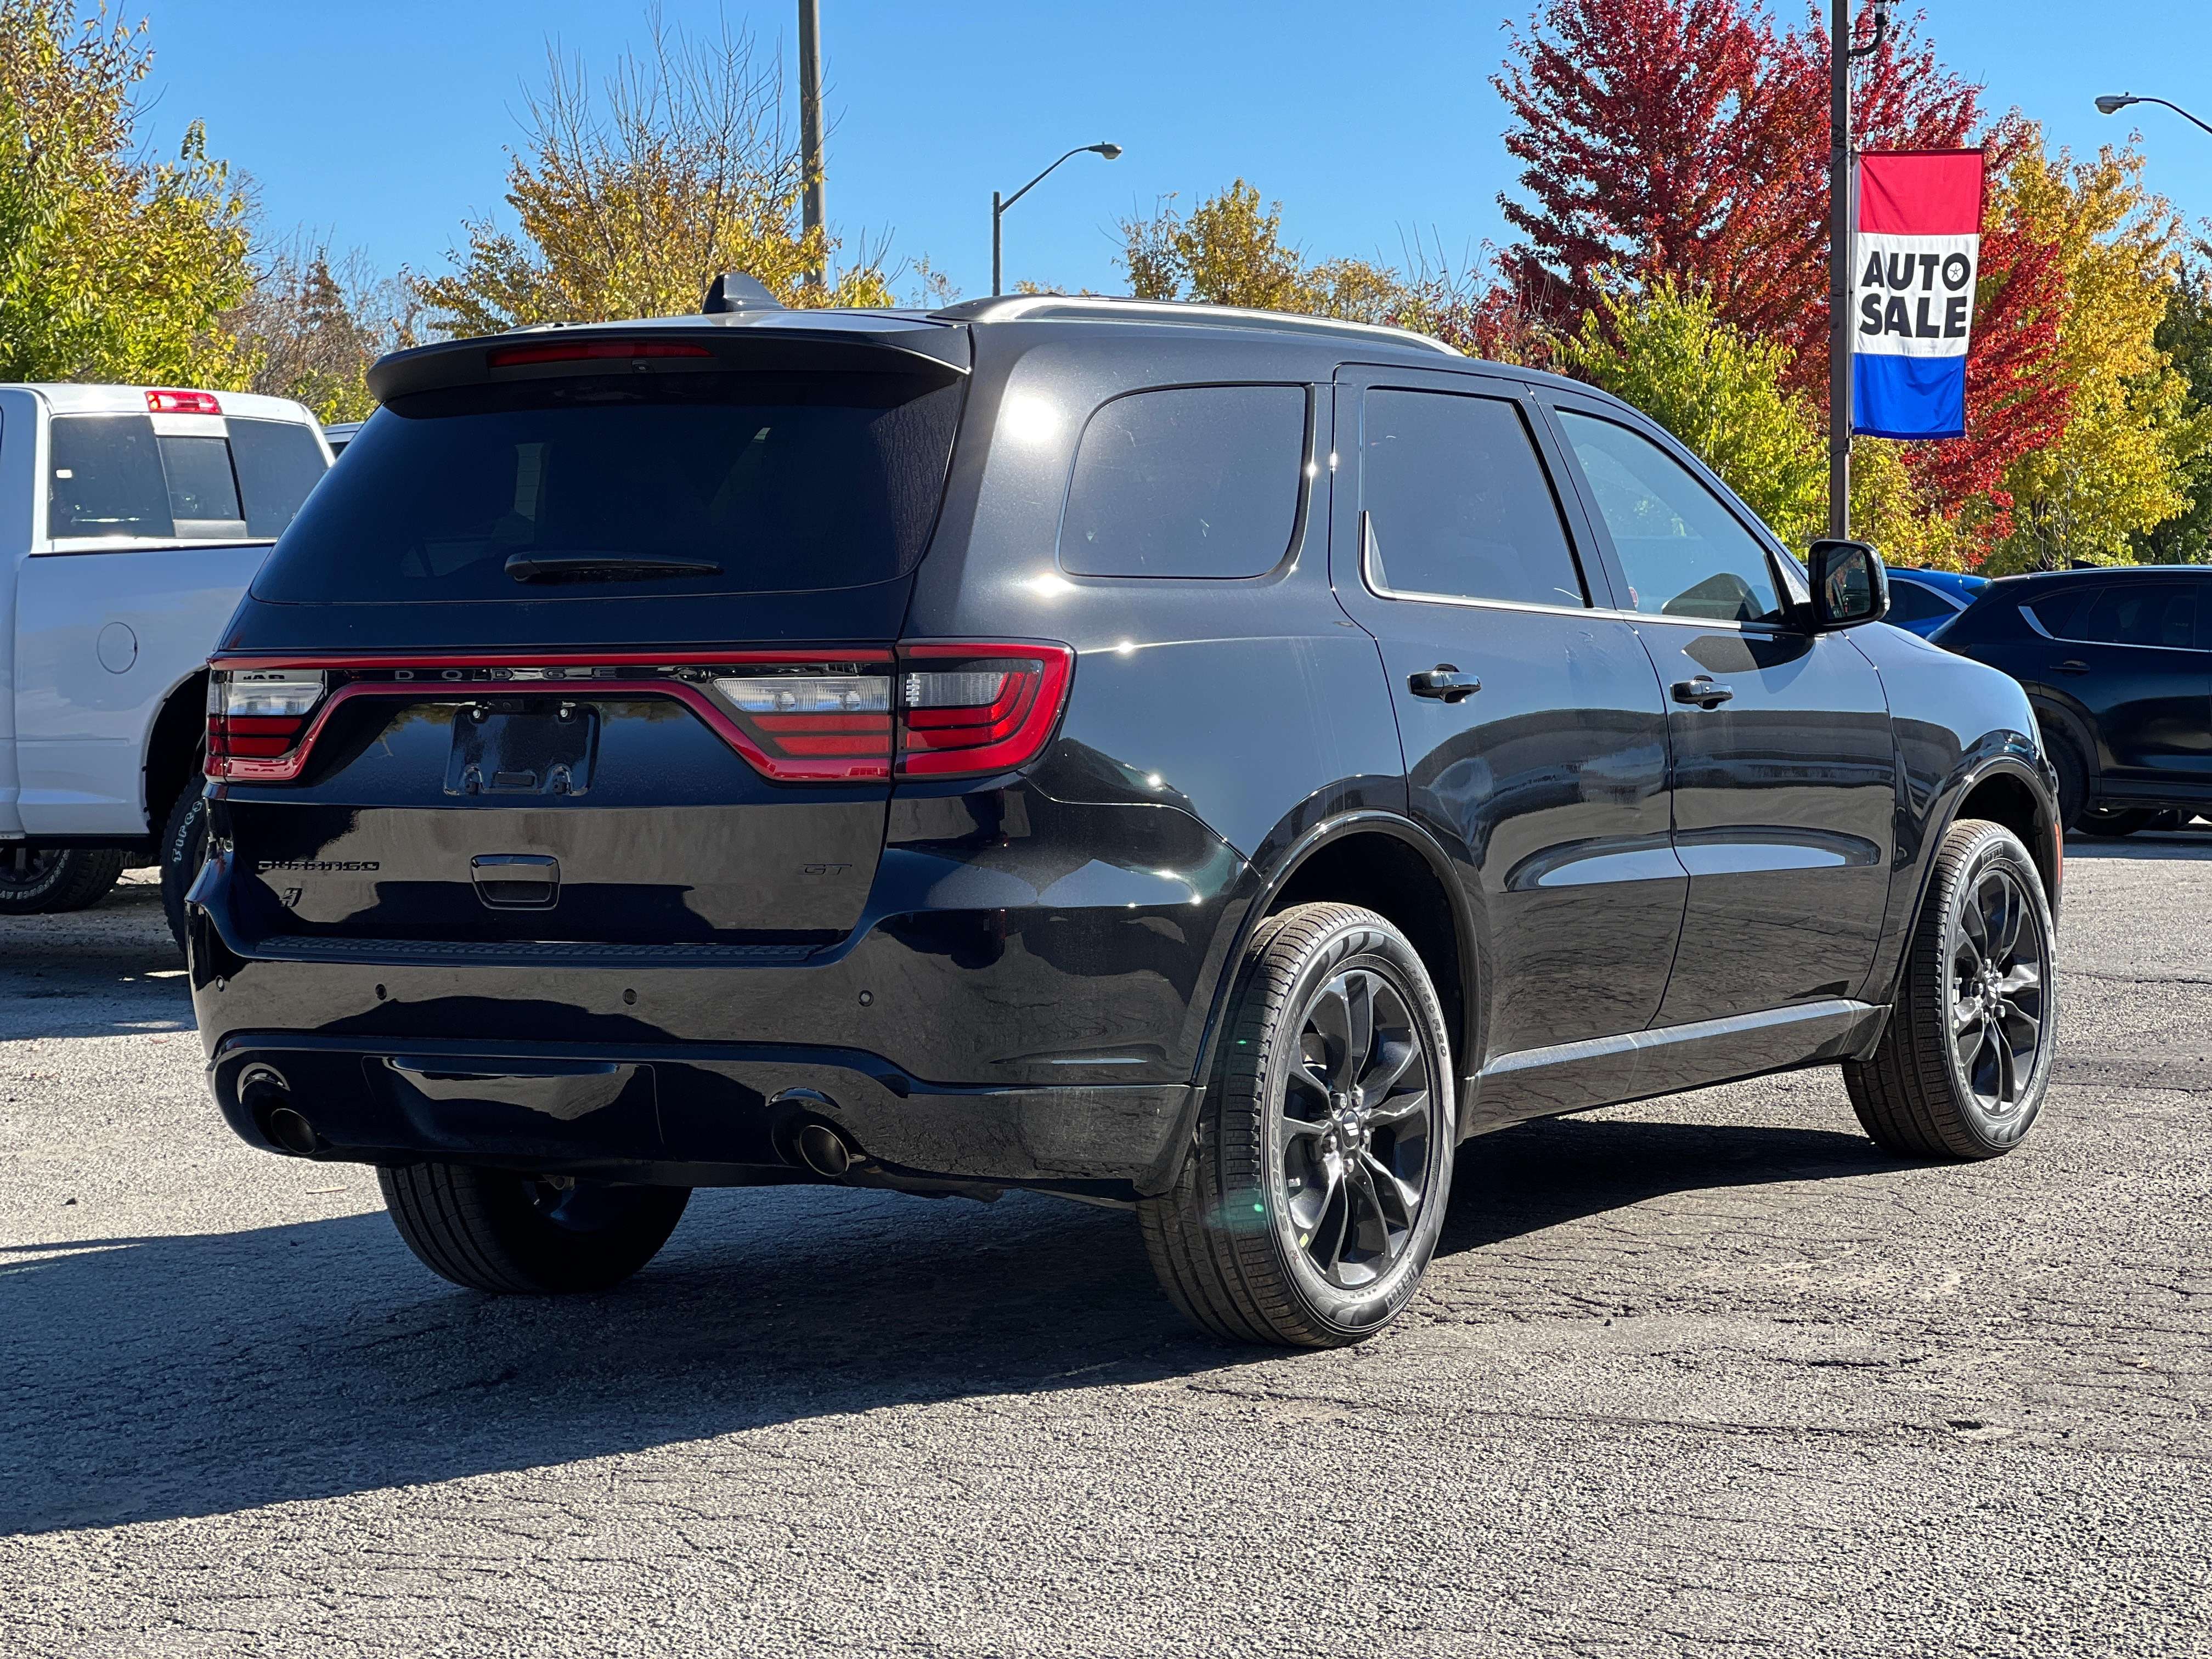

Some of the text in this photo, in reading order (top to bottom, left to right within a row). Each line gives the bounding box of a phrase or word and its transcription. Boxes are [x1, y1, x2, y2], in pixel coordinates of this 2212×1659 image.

[1861, 251, 1971, 291] AUTO
[1859, 293, 1967, 338] SALE
[394, 668, 616, 680] DODGE
[258, 861, 380, 871] DURANGO
[799, 863, 853, 875] GT
[1272, 1070, 1288, 1232] SCORPION
